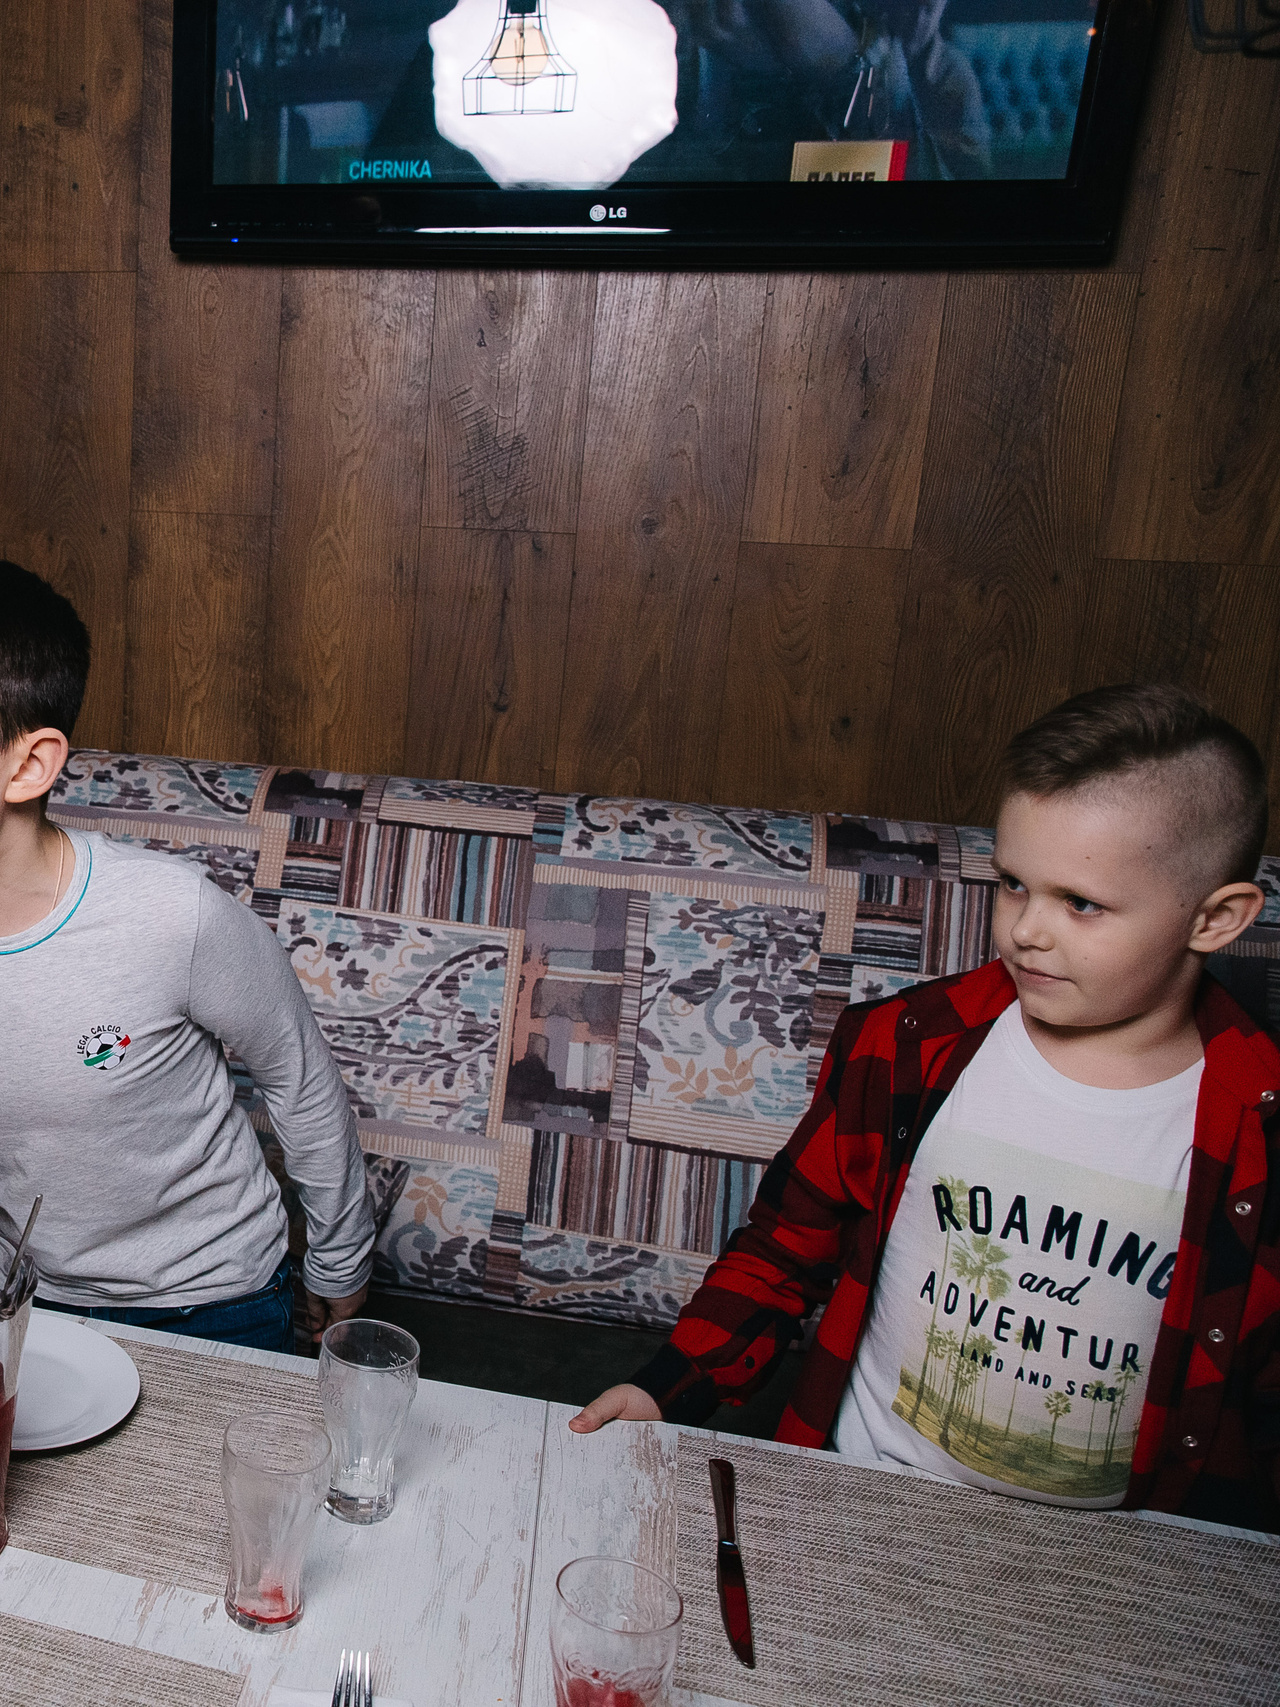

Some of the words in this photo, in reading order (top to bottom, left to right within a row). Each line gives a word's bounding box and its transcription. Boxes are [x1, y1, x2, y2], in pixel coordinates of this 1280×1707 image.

[349, 159, 432, 180] CHERNIKA
[608, 206, 628, 219] LG
[76, 1034, 90, 1055] LEGA
[90, 1024, 122, 1035] CALCIO
[931, 1183, 1179, 1301] ROAMING
[1018, 1271, 1091, 1306] and
[960, 1342, 1004, 1373] LAND
[1014, 1366, 1052, 1390] AND
[1064, 1379, 1117, 1403] SEAS
